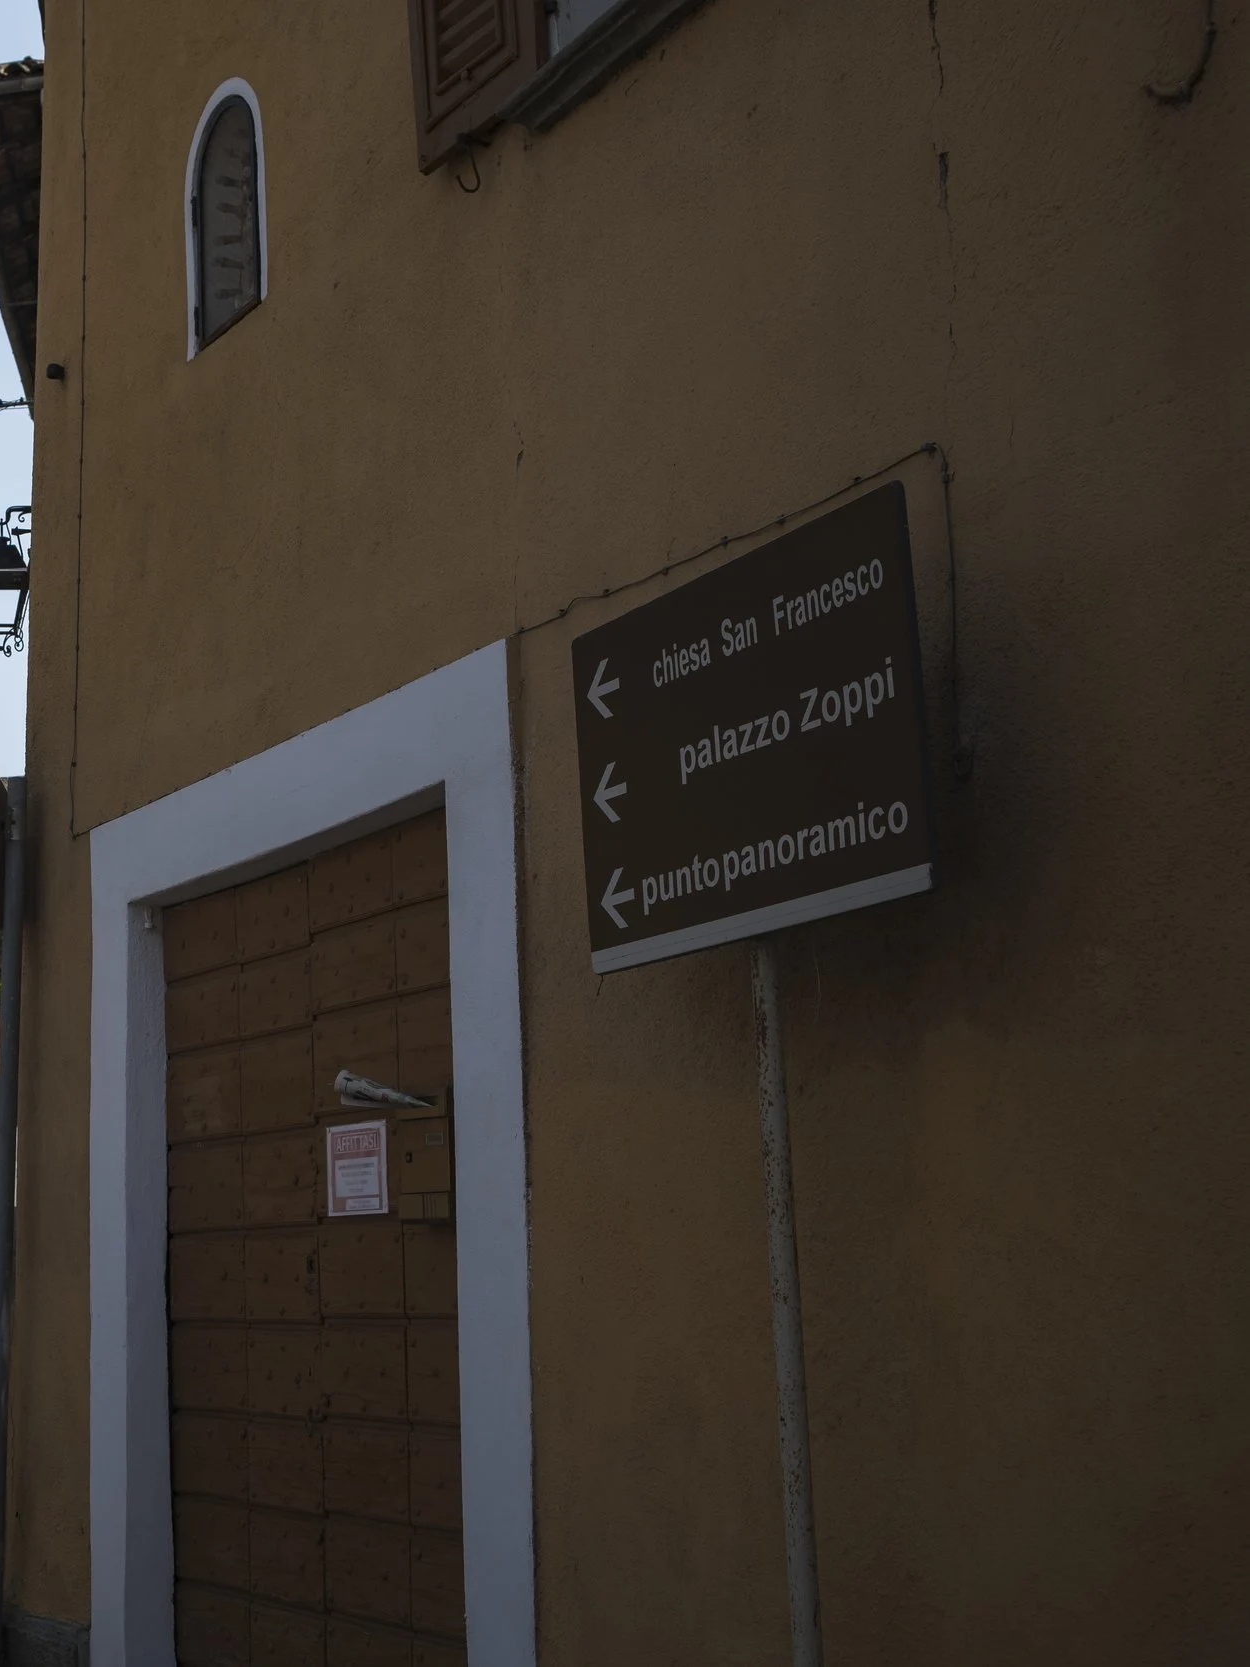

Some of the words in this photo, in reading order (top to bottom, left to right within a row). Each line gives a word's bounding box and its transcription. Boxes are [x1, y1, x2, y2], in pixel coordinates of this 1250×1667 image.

[652, 637, 711, 688] chiesa
[721, 616, 758, 657] San
[772, 557, 884, 636] Francesco
[679, 710, 791, 785] palazzo
[800, 657, 896, 733] Zoppi
[336, 1133, 377, 1152] AFFITTASI
